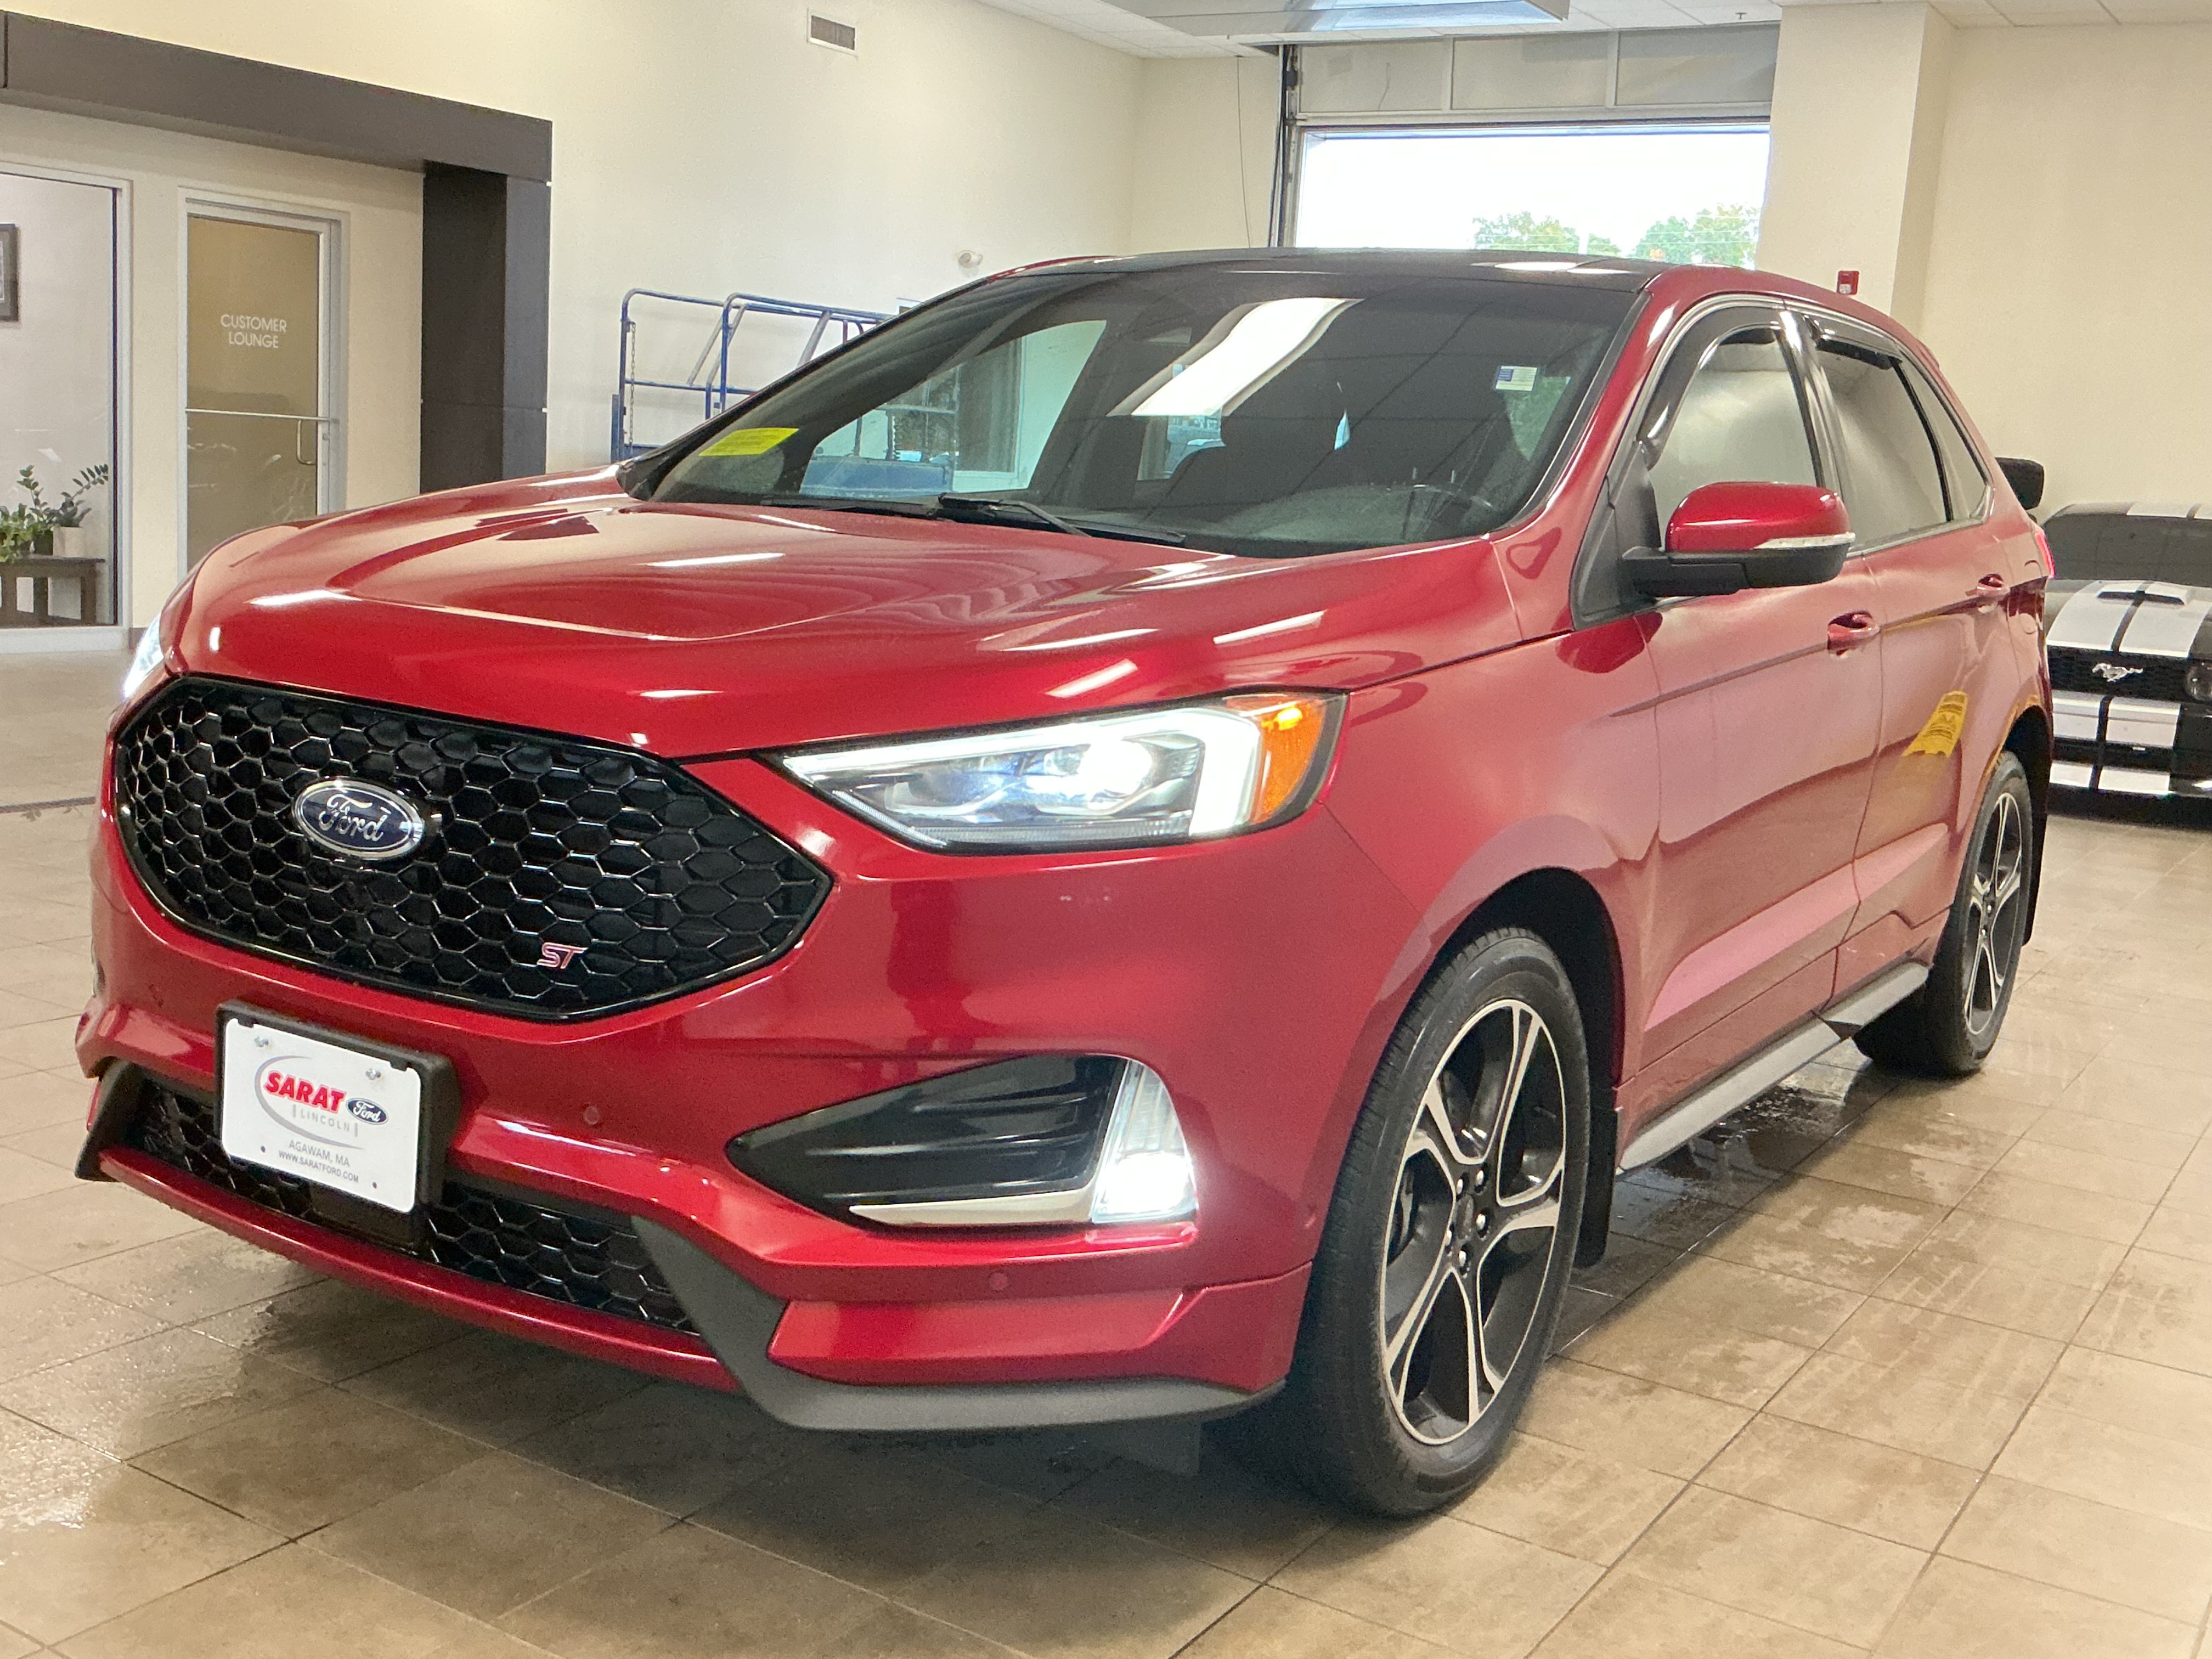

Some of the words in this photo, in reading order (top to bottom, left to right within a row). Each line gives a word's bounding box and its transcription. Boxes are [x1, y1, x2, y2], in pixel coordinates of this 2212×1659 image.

[221, 314, 287, 333] CUSTOMER
[229, 332, 279, 348] LOUNGE
[318, 793, 388, 842] Ford
[537, 942, 589, 969] ST
[264, 1070, 347, 1114] SARAT
[352, 1102, 381, 1123] Ford
[300, 1110, 350, 1132] LINCOLN
[279, 1150, 359, 1183] WWW.SARATFORD.COM
[289, 1139, 333, 1164] AGAWAM,
[335, 1154, 350, 1167] MA
